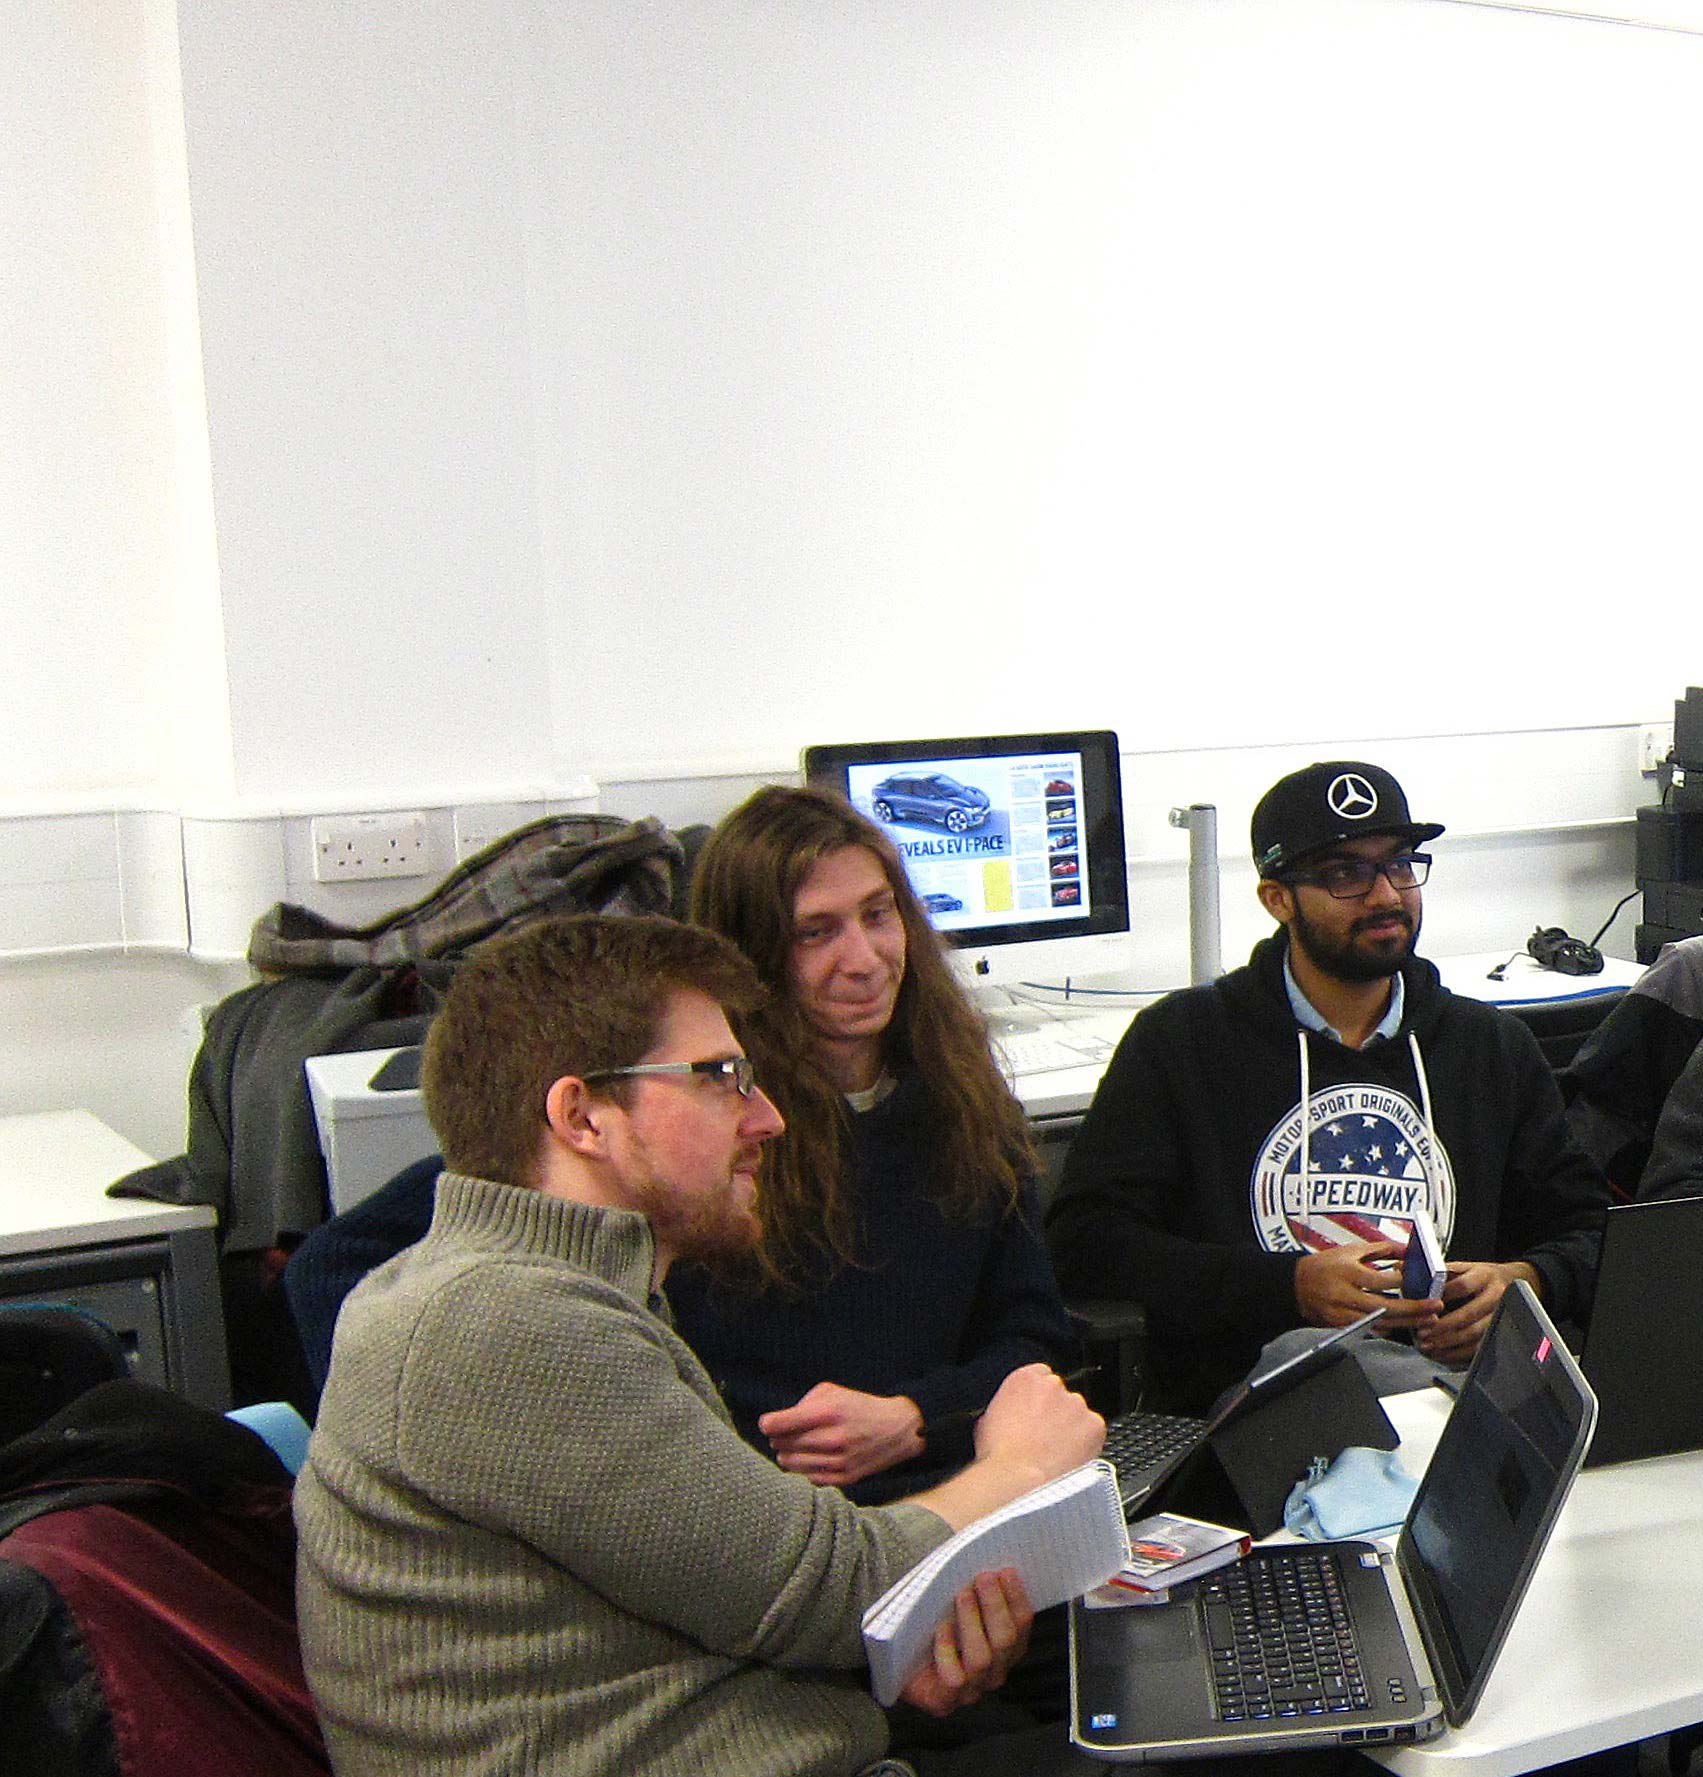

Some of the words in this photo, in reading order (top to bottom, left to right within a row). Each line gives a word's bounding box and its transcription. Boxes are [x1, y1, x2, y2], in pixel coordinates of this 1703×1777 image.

[899, 839, 945, 857] VEALS
[947, 838, 961, 854] EV
[965, 835, 1004, 853] I-PACE
[1360, 1093, 1420, 1139] ORIGINALS
